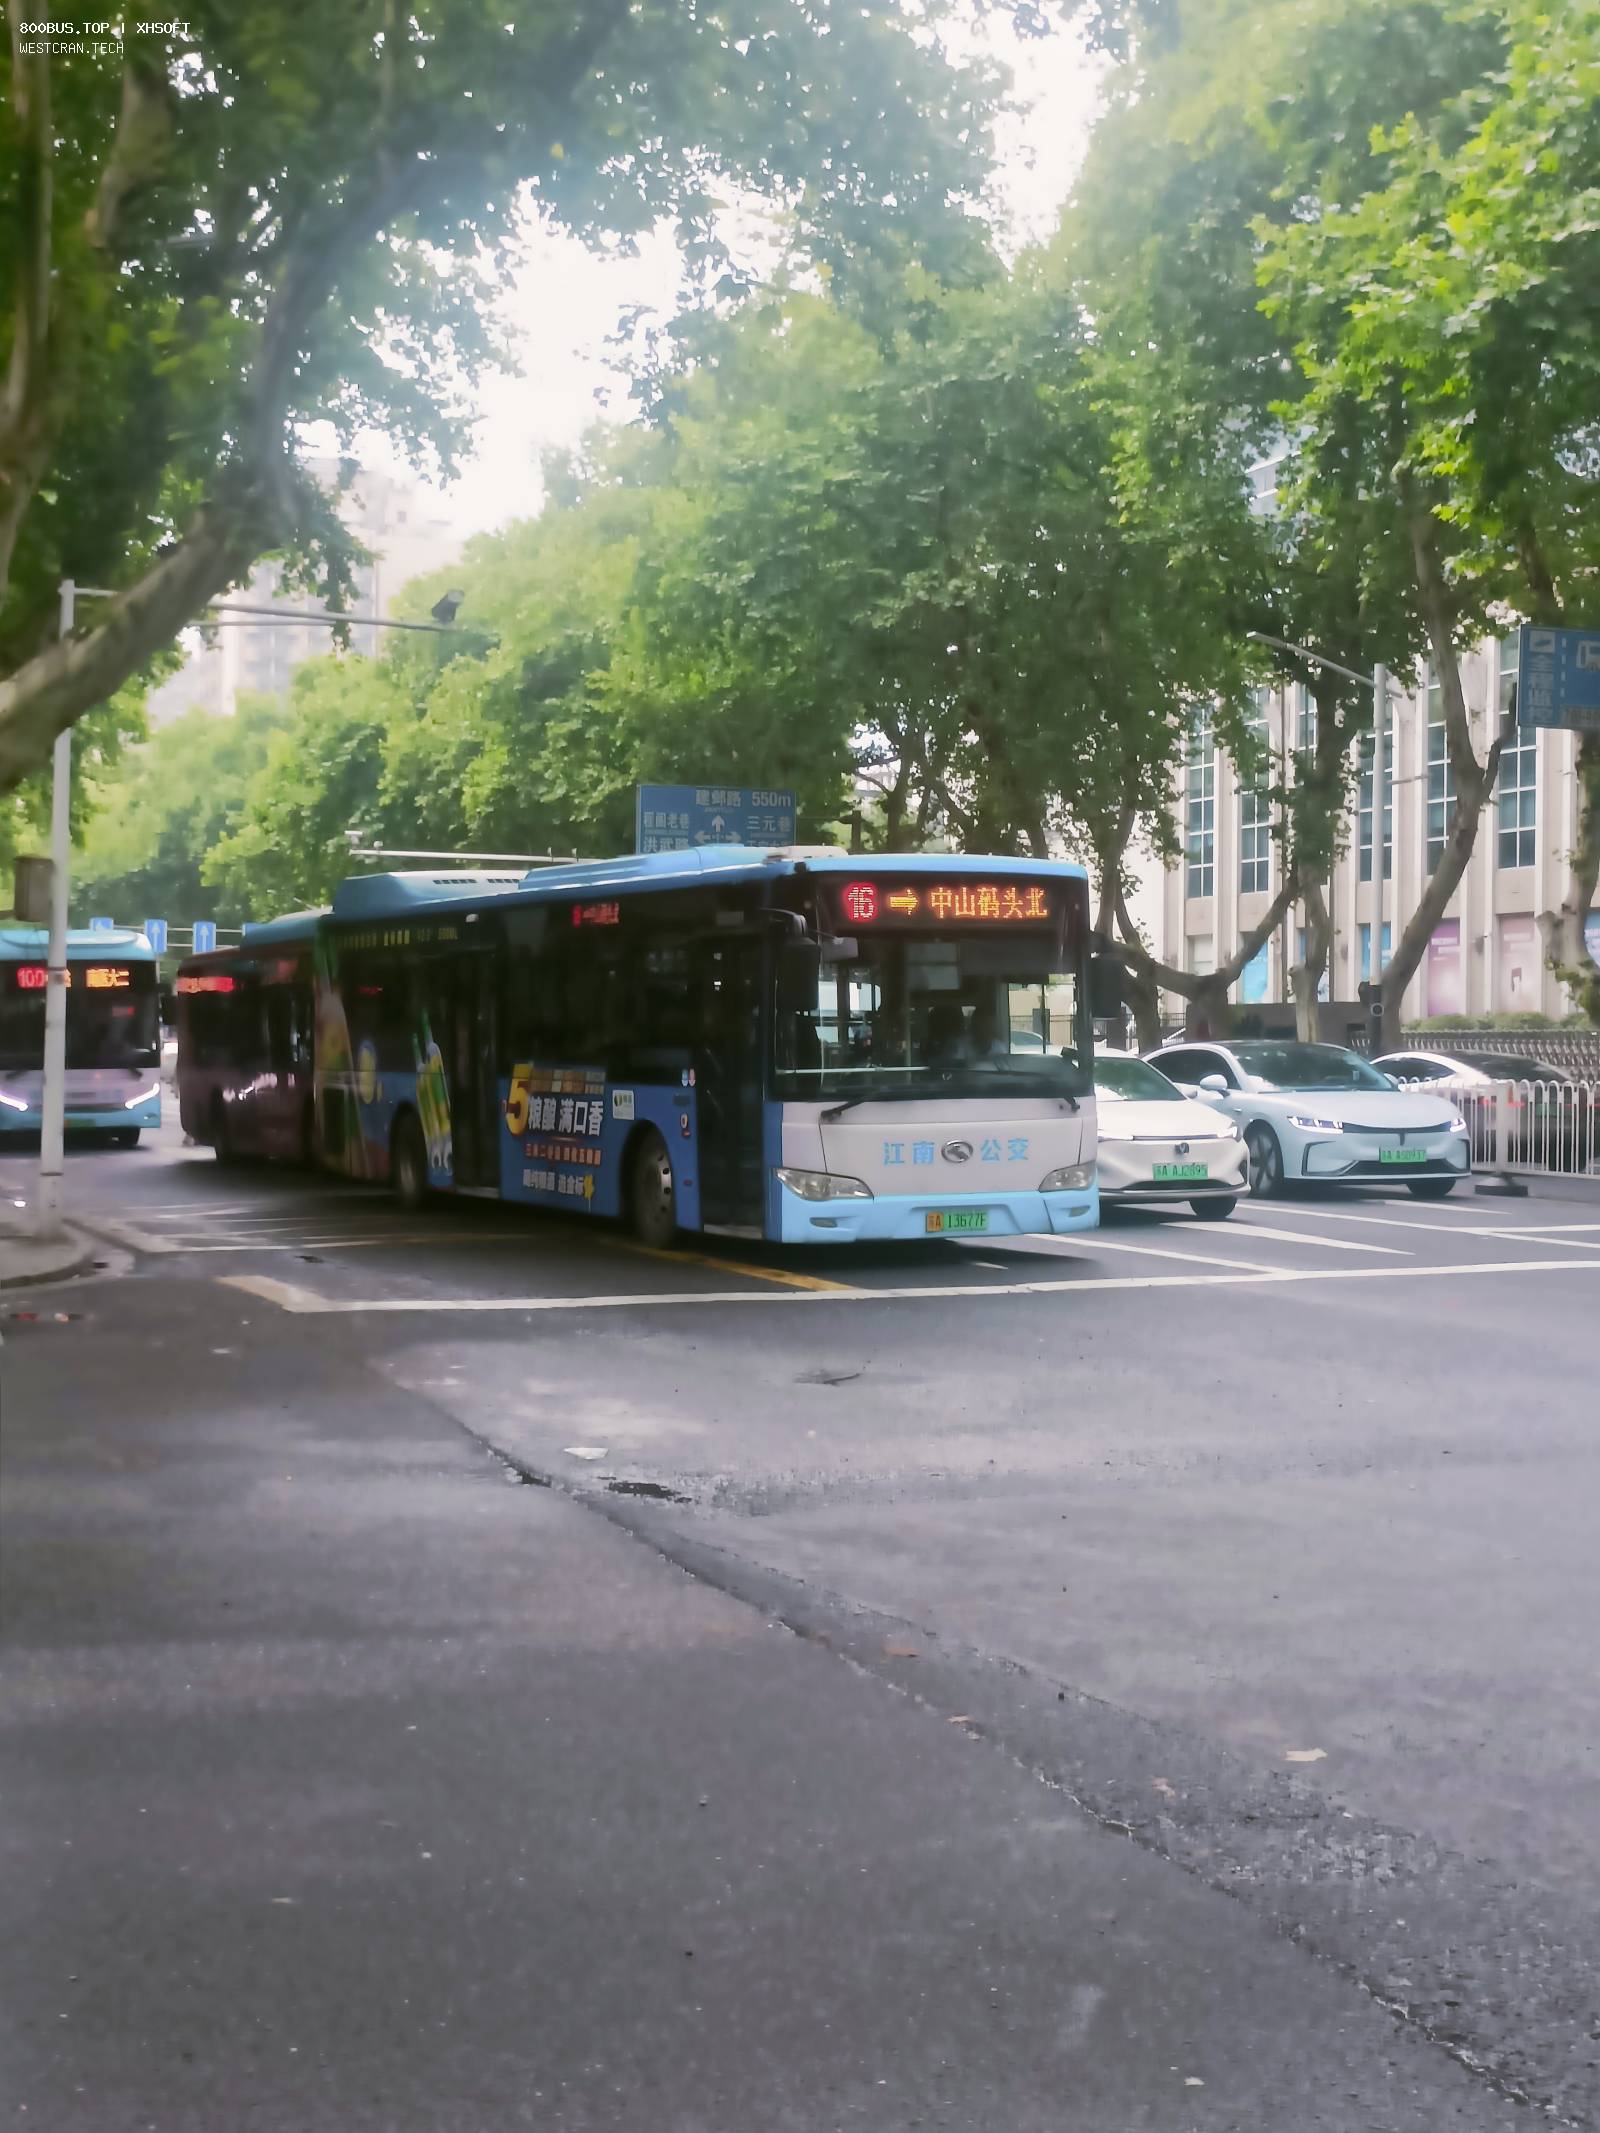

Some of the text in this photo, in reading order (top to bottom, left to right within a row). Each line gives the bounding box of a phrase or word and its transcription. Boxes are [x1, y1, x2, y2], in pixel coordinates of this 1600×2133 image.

[751, 791, 791, 808] 550m
[848, 887, 874, 918] 16
[930, 887, 1048, 919] 中山码头北
[883, 1138, 1029, 1166] 江南 公交
